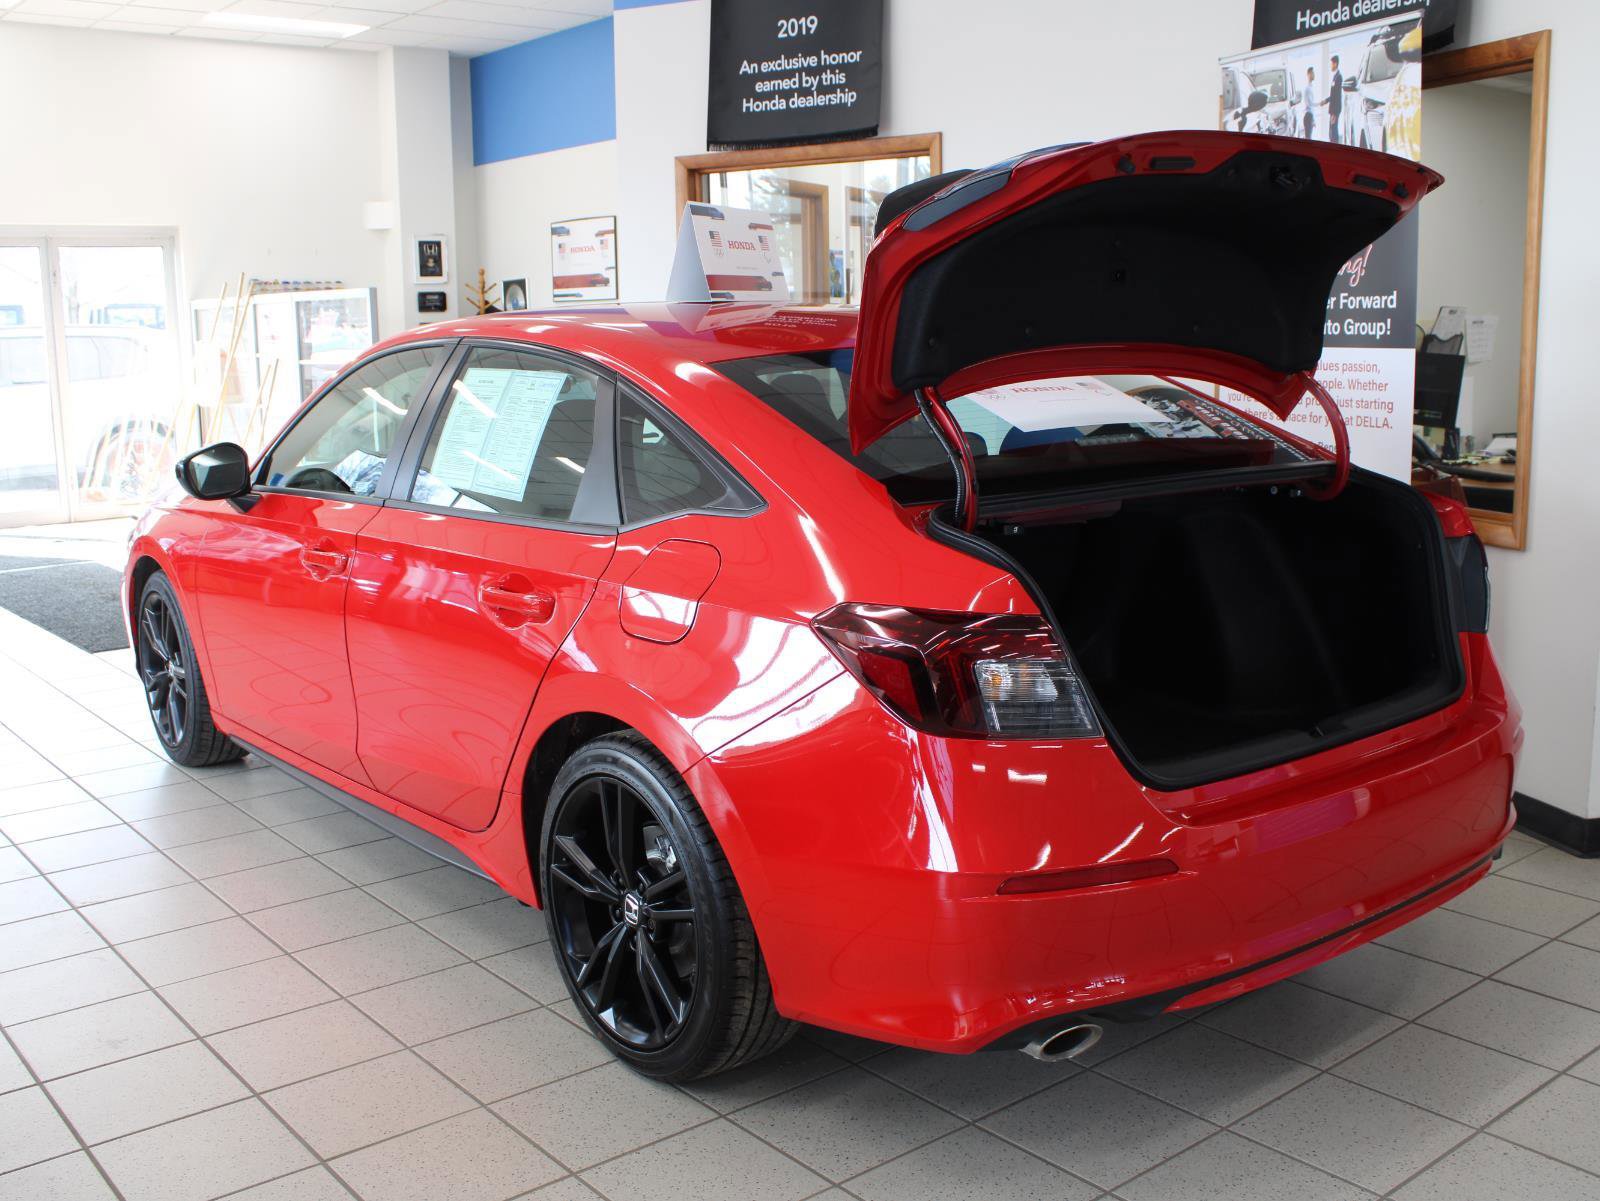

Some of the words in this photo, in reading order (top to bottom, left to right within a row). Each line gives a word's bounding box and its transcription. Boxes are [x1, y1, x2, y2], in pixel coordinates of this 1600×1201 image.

[777, 15, 818, 38] 2019
[1296, 1, 1350, 30] Honda
[739, 60, 758, 75] An
[761, 53, 818, 73] exclusive
[821, 50, 862, 66] honor
[755, 72, 799, 92] earned
[802, 71, 819, 91] by
[822, 69, 846, 86] this
[742, 94, 786, 113] Honda
[789, 89, 857, 109] dealership
[727, 240, 756, 250] HONDA
[1337, 243, 1373, 287] ng!
[1339, 290, 1398, 309] Forward
[1344, 318, 1391, 340] Group!
[1316, 360, 1340, 372] lues
[1341, 360, 1381, 374] passion,
[1347, 379, 1389, 392] Whether
[1355, 398, 1394, 413] starting
[1308, 411, 1323, 423] for
[1355, 415, 1393, 429] DELLA.
